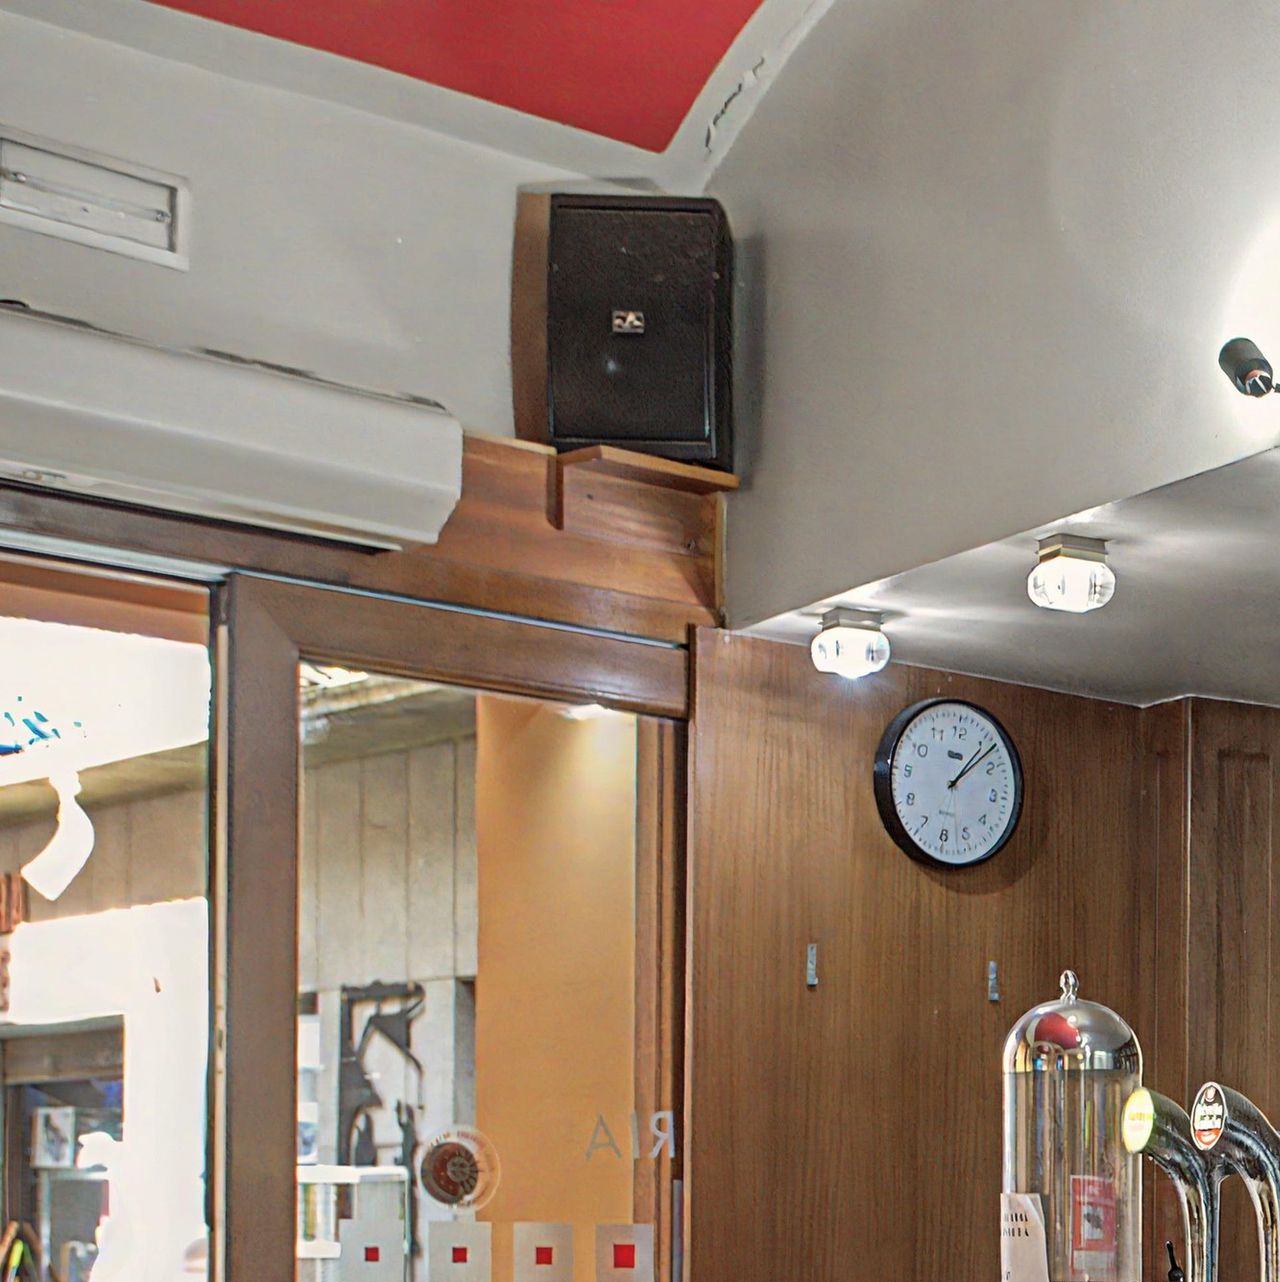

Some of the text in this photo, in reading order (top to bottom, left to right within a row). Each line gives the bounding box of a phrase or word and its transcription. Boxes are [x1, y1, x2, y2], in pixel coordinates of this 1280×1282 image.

[931, 727, 945, 741] 11
[952, 725, 968, 741] 12
[985, 761, 996, 776] 2
[906, 792, 915, 806] 8
[988, 787, 998, 803] 3
[919, 815, 929, 828] 7
[978, 813, 987, 826] 4
[938, 828, 949, 842] 6
[961, 826, 971, 841] 5
